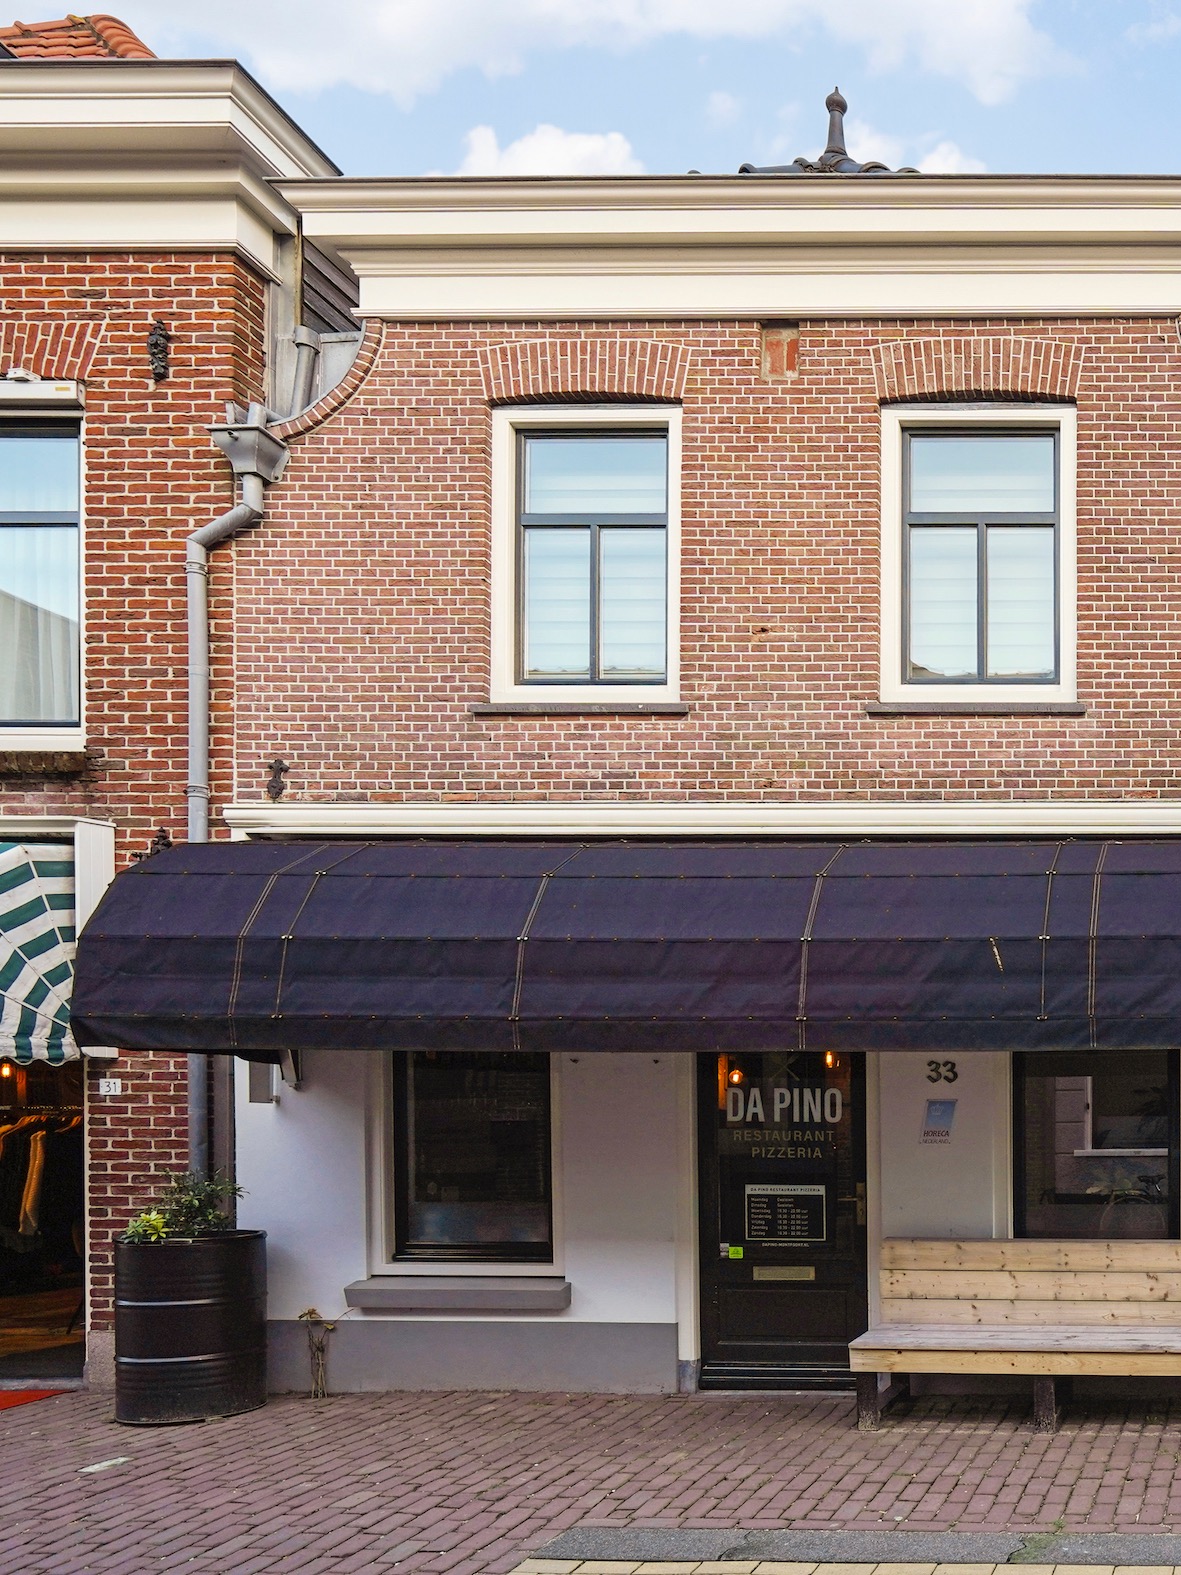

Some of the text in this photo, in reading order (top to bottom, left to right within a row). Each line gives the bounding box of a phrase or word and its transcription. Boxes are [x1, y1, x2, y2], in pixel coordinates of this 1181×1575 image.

[926, 1060, 959, 1084] 33
[104, 1081, 117, 1093] 31
[726, 1087, 843, 1123] DA PINO
[733, 1130, 835, 1141] RESTAURANT
[751, 1147, 823, 1158] PIZZERIA
